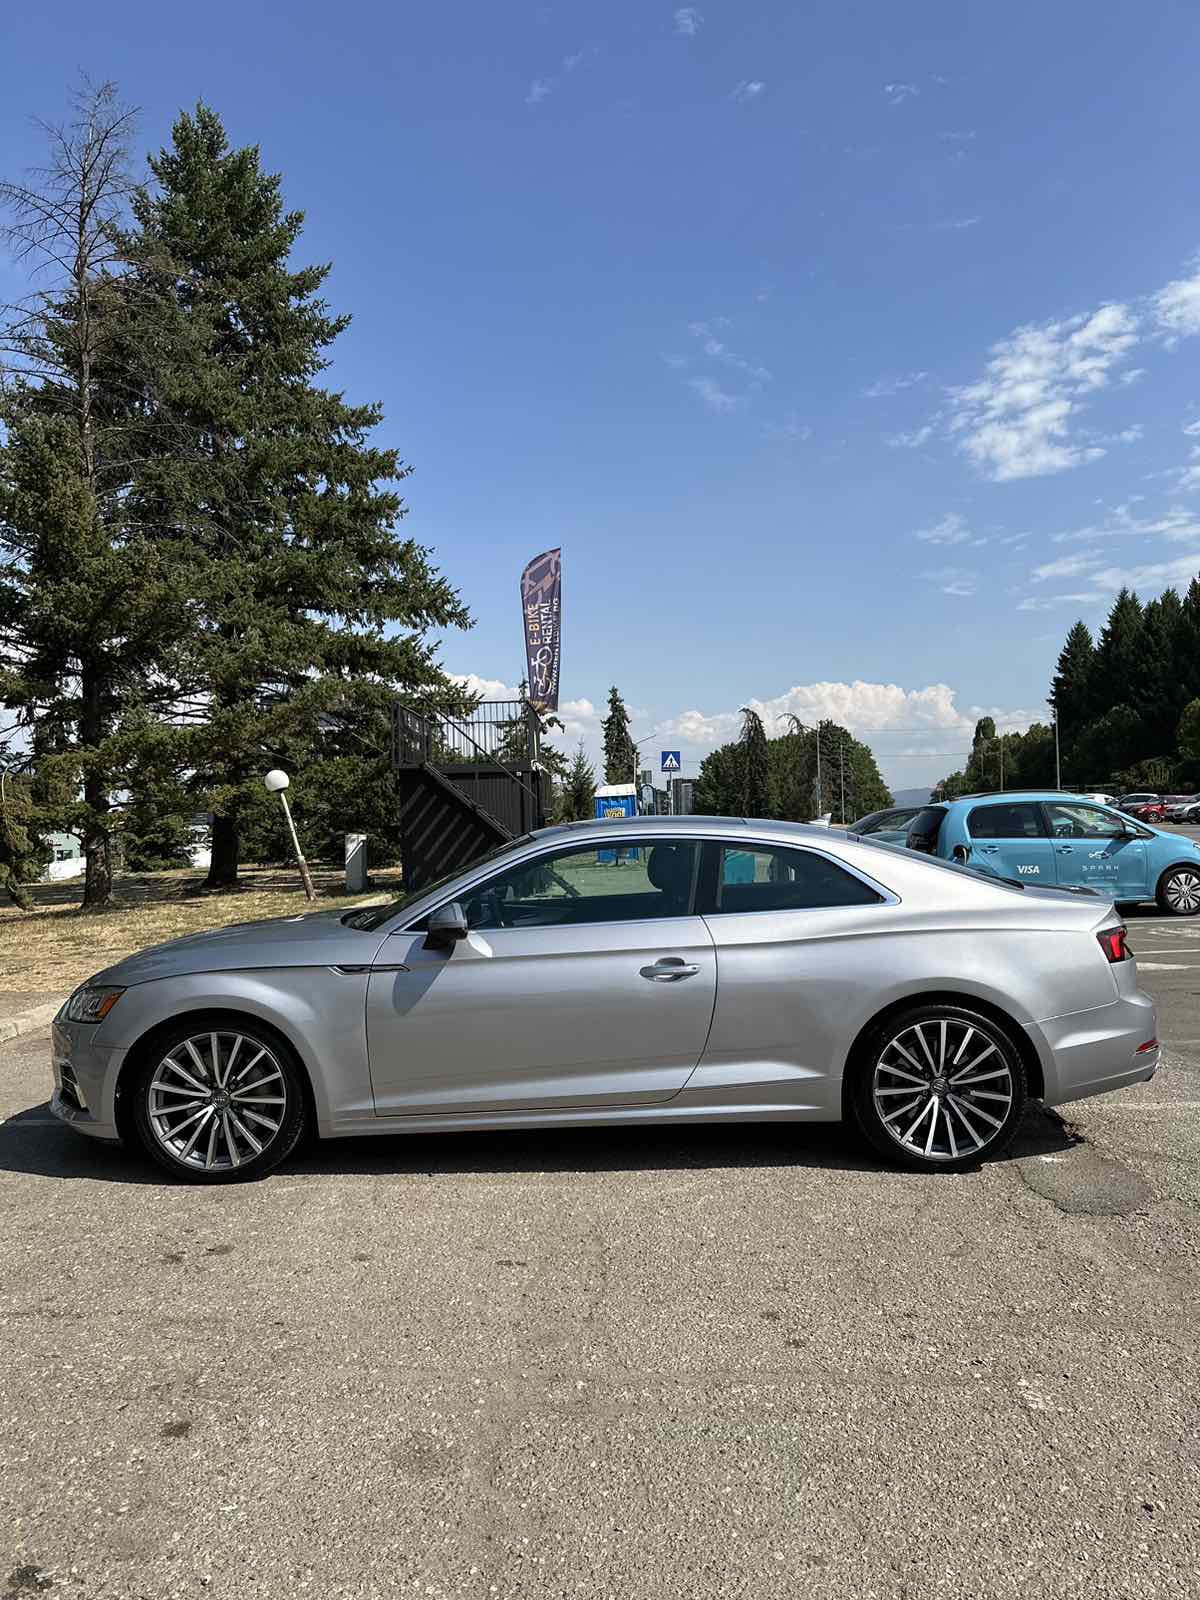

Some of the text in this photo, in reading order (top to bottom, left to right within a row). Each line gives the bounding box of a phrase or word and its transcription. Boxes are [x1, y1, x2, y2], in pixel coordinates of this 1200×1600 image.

[527, 603, 541, 645] E-BIKE
[540, 600, 552, 644] RENTAL
[1016, 865, 1040, 874] VISA
